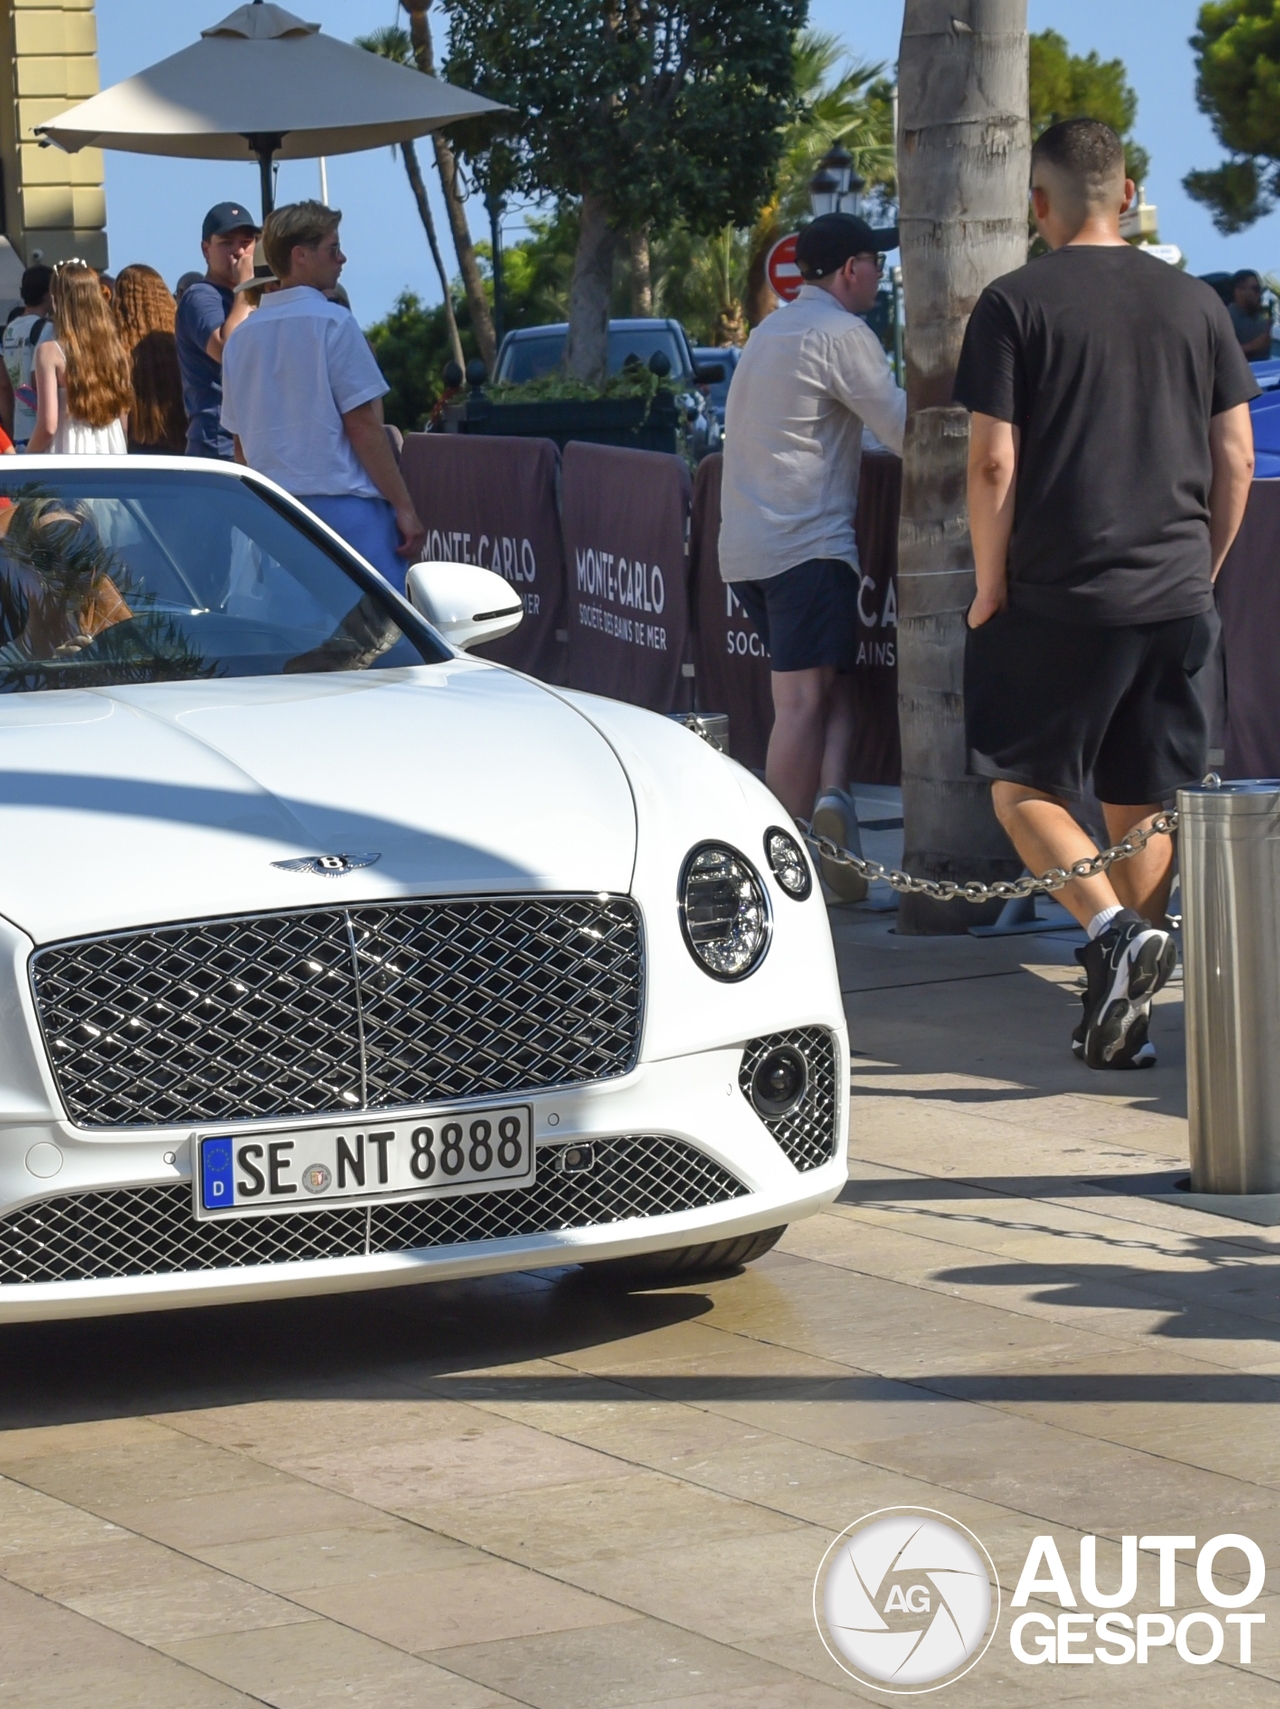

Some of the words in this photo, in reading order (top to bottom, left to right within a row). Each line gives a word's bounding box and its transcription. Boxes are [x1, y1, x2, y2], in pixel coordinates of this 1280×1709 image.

[634, 620, 645, 646] DE
[646, 624, 667, 651] MER
[212, 1180, 225, 1197] D
[237, 1140, 298, 1197] SE
[336, 1131, 396, 1189] NT
[409, 1115, 523, 1181] 8888
